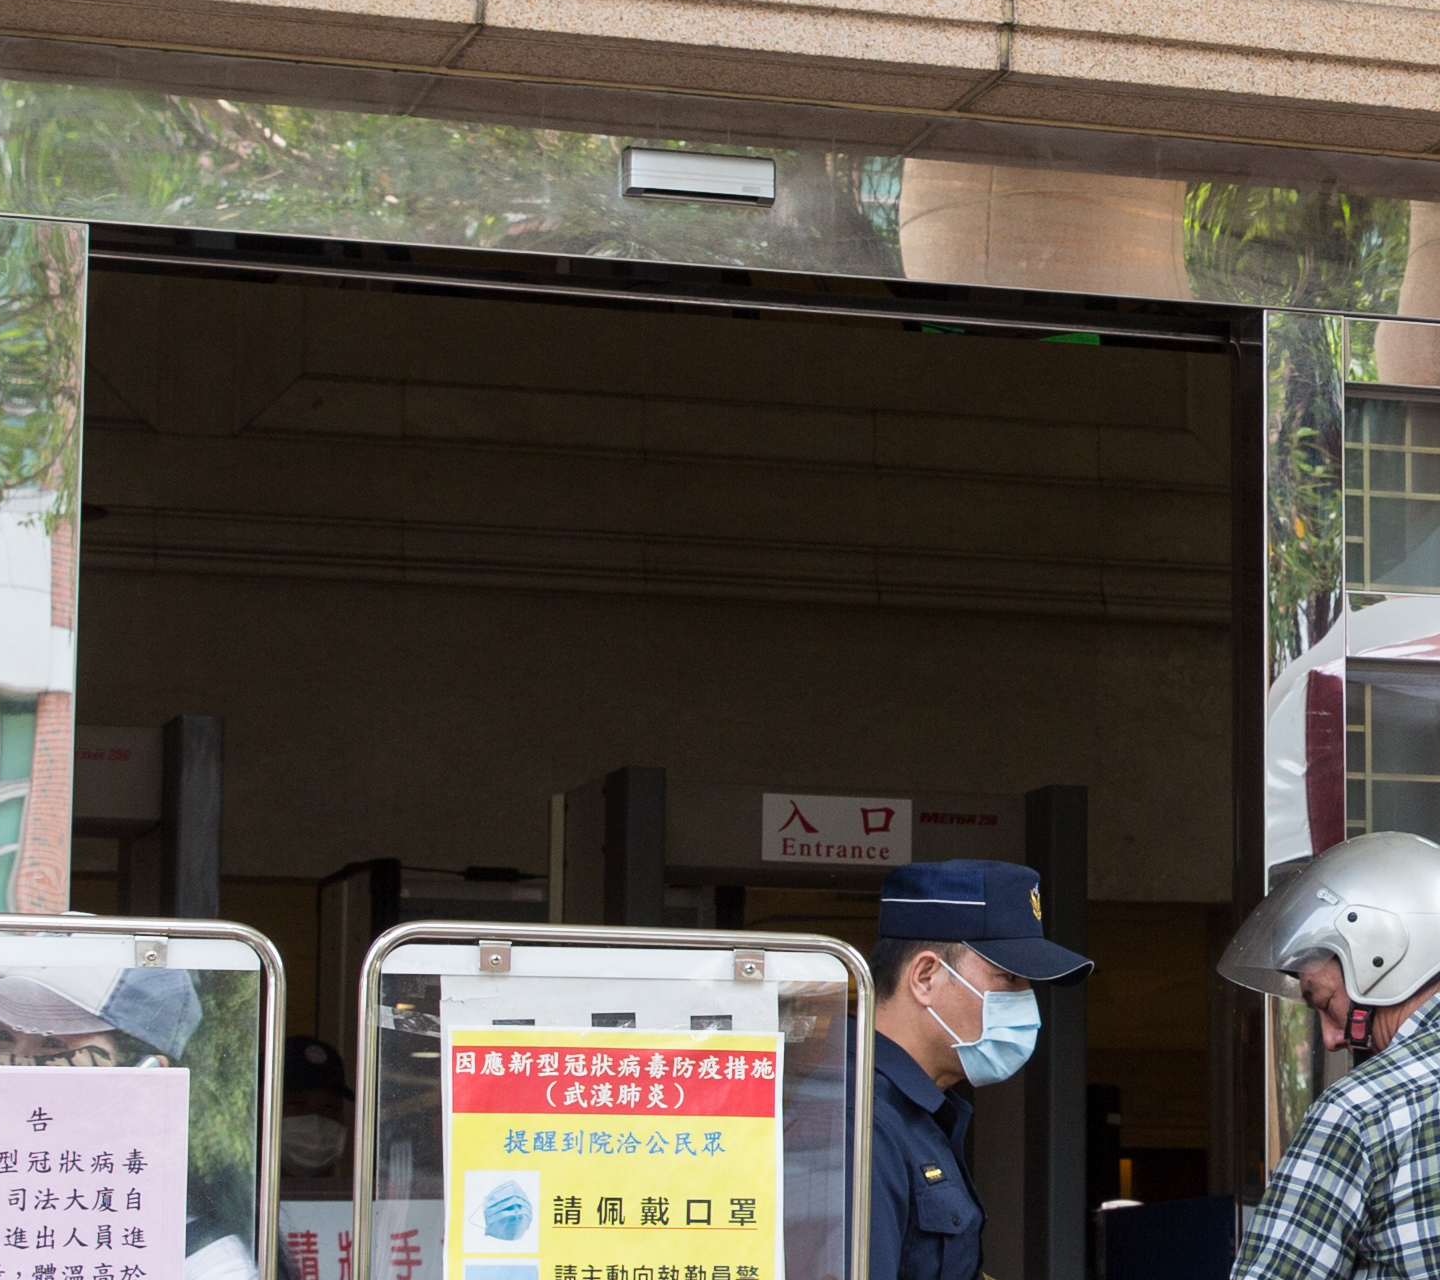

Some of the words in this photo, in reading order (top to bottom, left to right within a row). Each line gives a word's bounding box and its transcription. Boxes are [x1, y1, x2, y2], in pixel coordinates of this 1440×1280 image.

[778, 799, 895, 836] 入口
[781, 838, 891, 860] Entrance
[455, 1051, 776, 1081] 因應新型冠狀病毒防疫措施
[503, 1129, 726, 1156] 提醒到院洽公民眾
[553, 1195, 757, 1227] 請佩戴口罩
